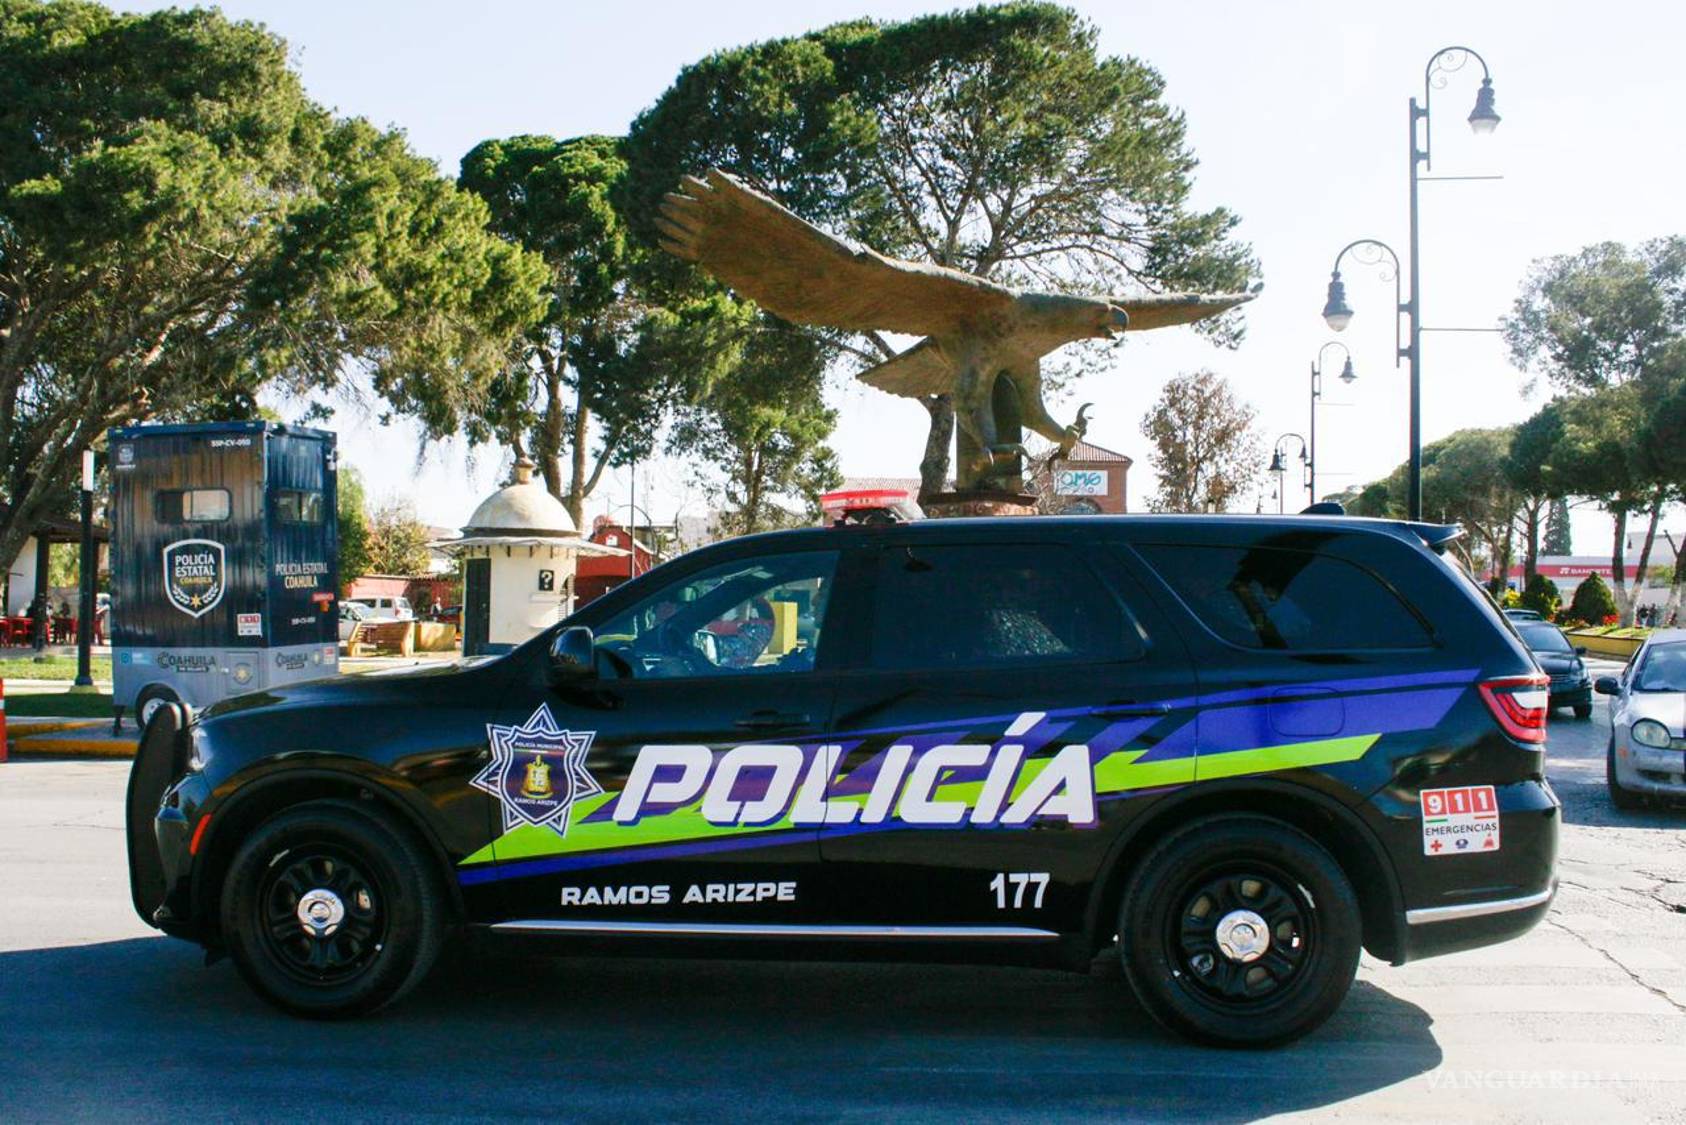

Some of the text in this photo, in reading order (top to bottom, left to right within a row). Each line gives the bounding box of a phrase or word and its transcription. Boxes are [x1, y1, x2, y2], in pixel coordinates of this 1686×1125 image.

[175, 551, 215, 566] POLICÍA
[175, 565, 216, 577] ESTATAL
[284, 575, 318, 588] COAHUILA
[157, 652, 216, 669] COAHUILA
[612, 711, 1096, 825] POLICÍA
[1427, 790, 1489, 814] 911
[1425, 823, 1497, 836] EMERGENCIAS
[561, 880, 797, 906] RAMOS ARIZPE
[989, 871, 1050, 909] 177
